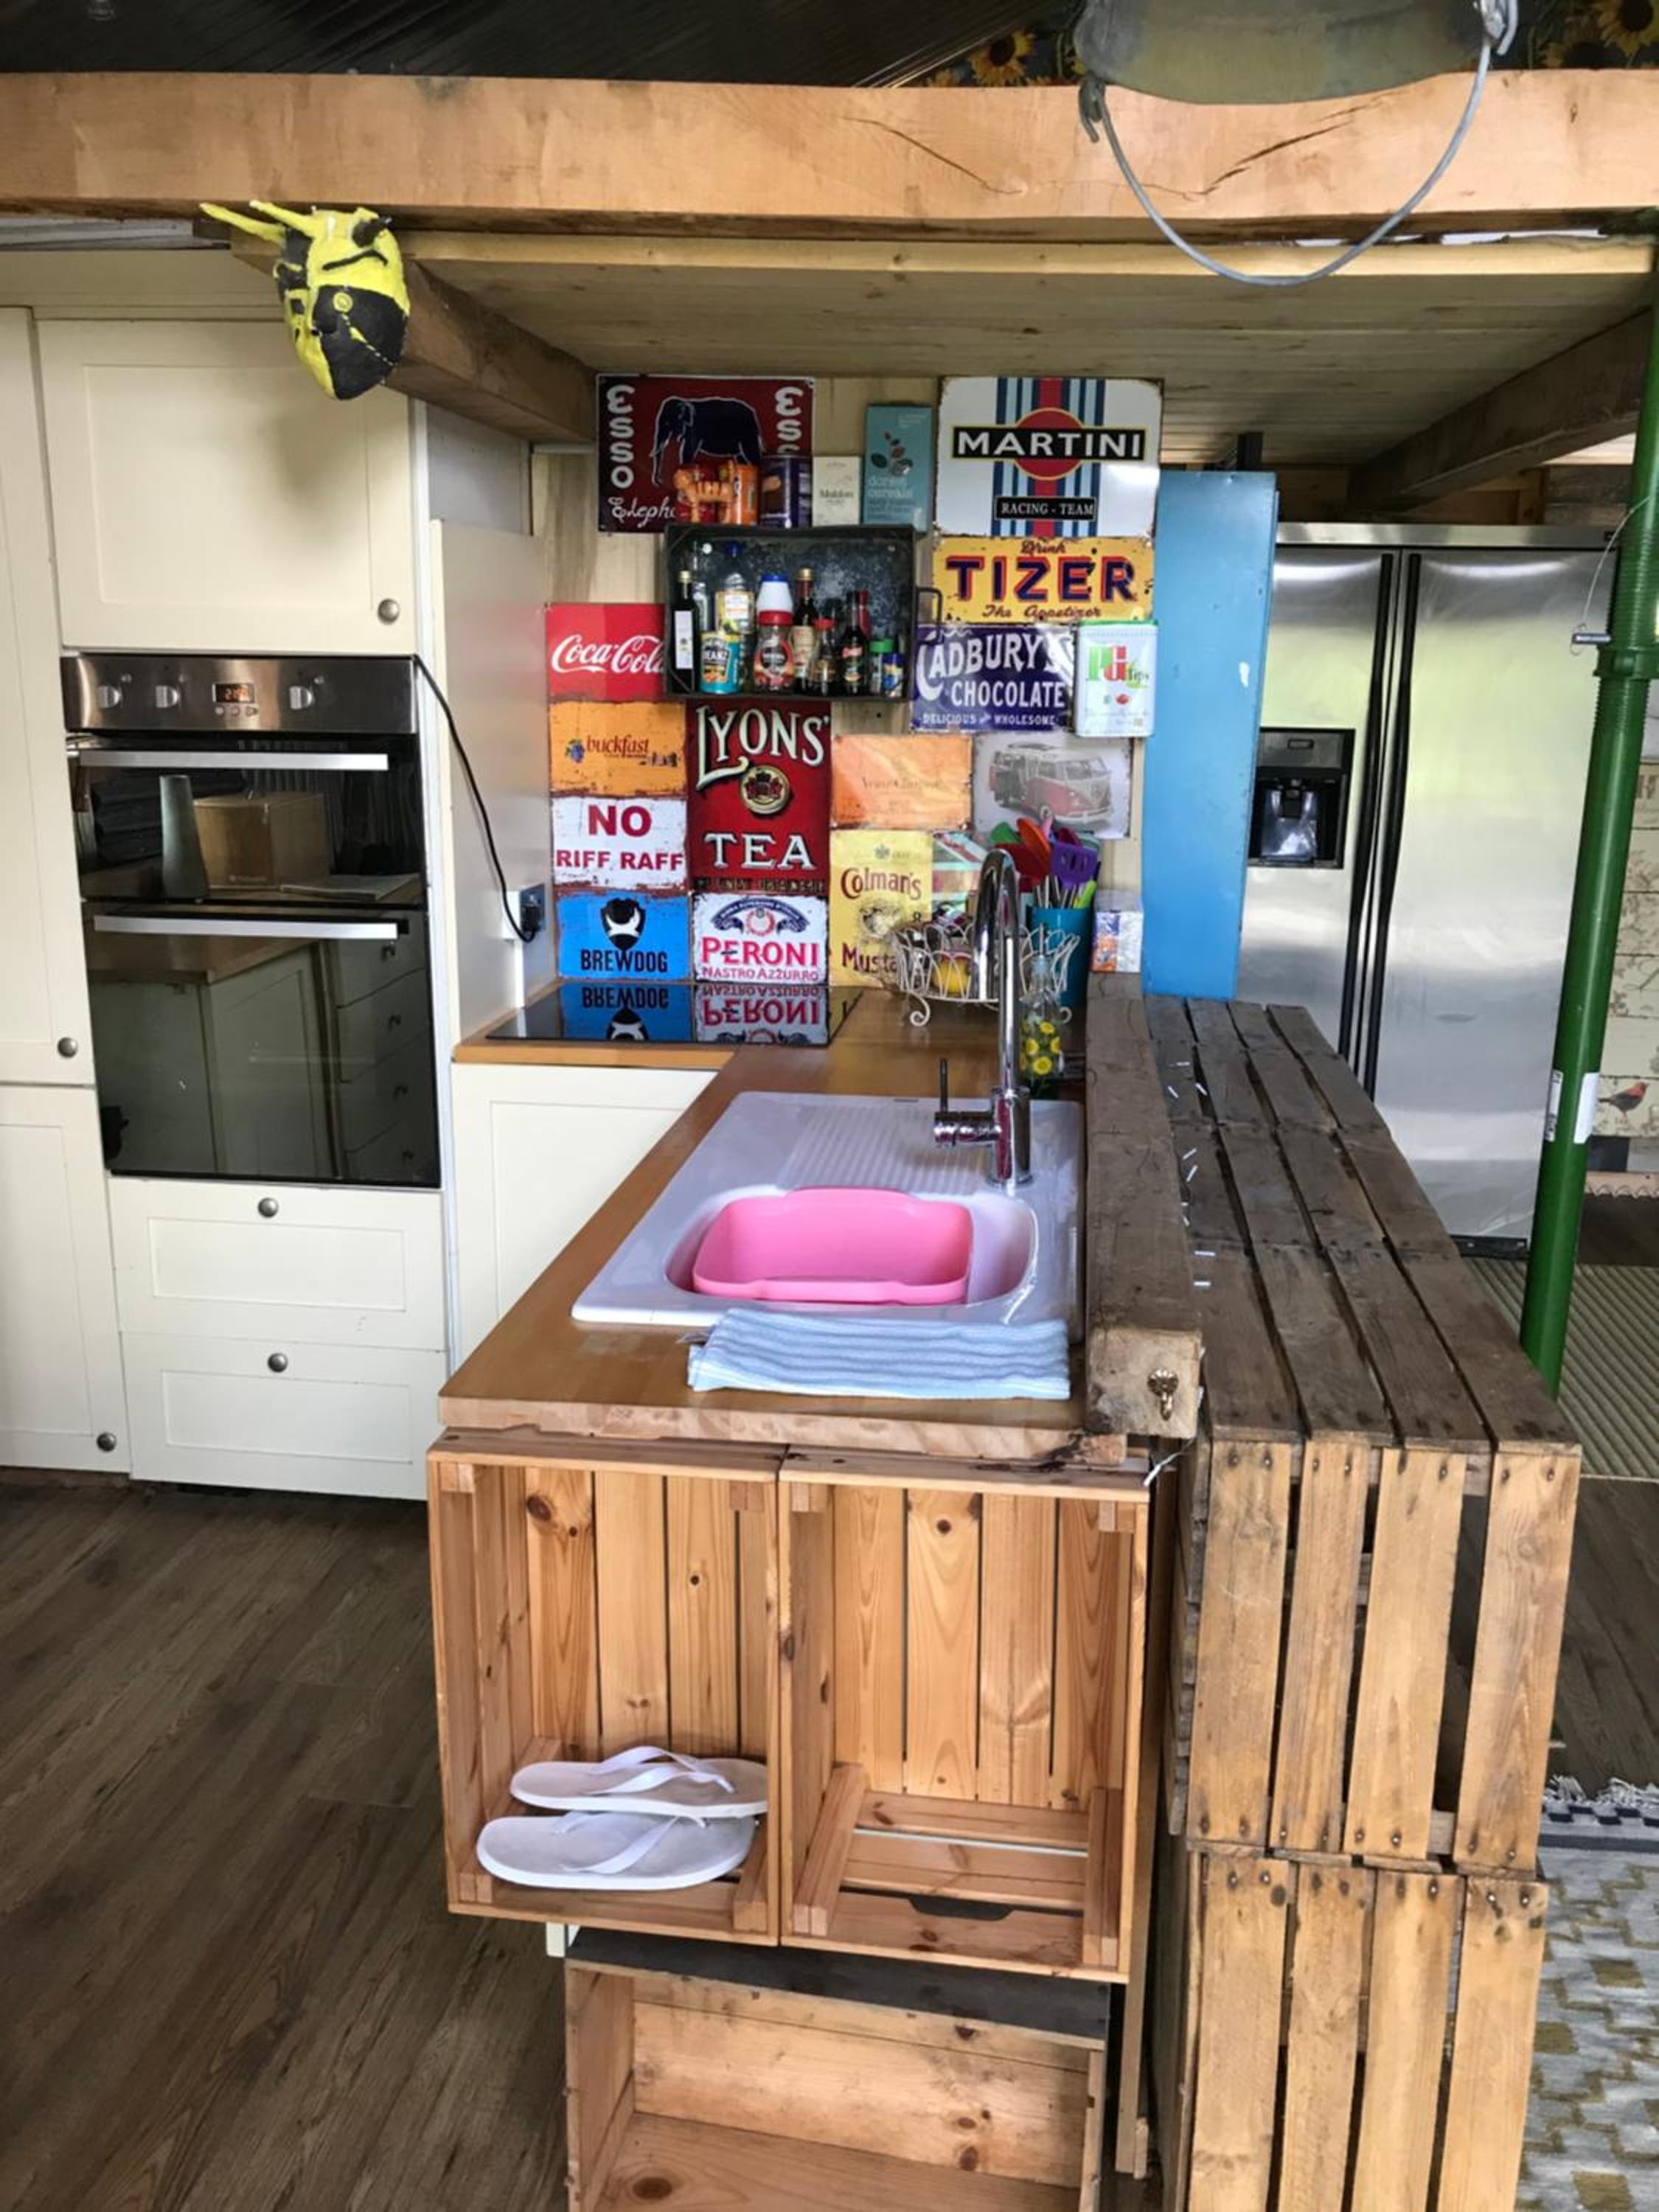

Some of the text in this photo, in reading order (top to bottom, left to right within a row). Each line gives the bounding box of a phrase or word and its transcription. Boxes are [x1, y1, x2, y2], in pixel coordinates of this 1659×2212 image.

[607, 384, 636, 489] ESSO
[959, 431, 1140, 456] MARTINI
[608, 495, 675, 528] Eleph
[1001, 502, 1093, 515] RACING TEAM
[1021, 540, 1065, 554] Drink
[945, 556, 1136, 602] TIZER
[982, 605, 1012, 618] The
[951, 681, 1065, 709] CHOCOLATE
[922, 713, 977, 725] DELICIOUS
[995, 714, 1057, 725] WHOLESOME
[586, 734, 650, 758] buckfast
[588, 804, 652, 838] NO
[557, 849, 684, 871] RIFF RAFF
[704, 832, 817, 870] TEA
[841, 866, 921, 900] Colman's
[581, 948, 669, 973] BREWDOG
[702, 936, 819, 967] PERONI
[703, 967, 819, 981] NASTRO AZZURRO
